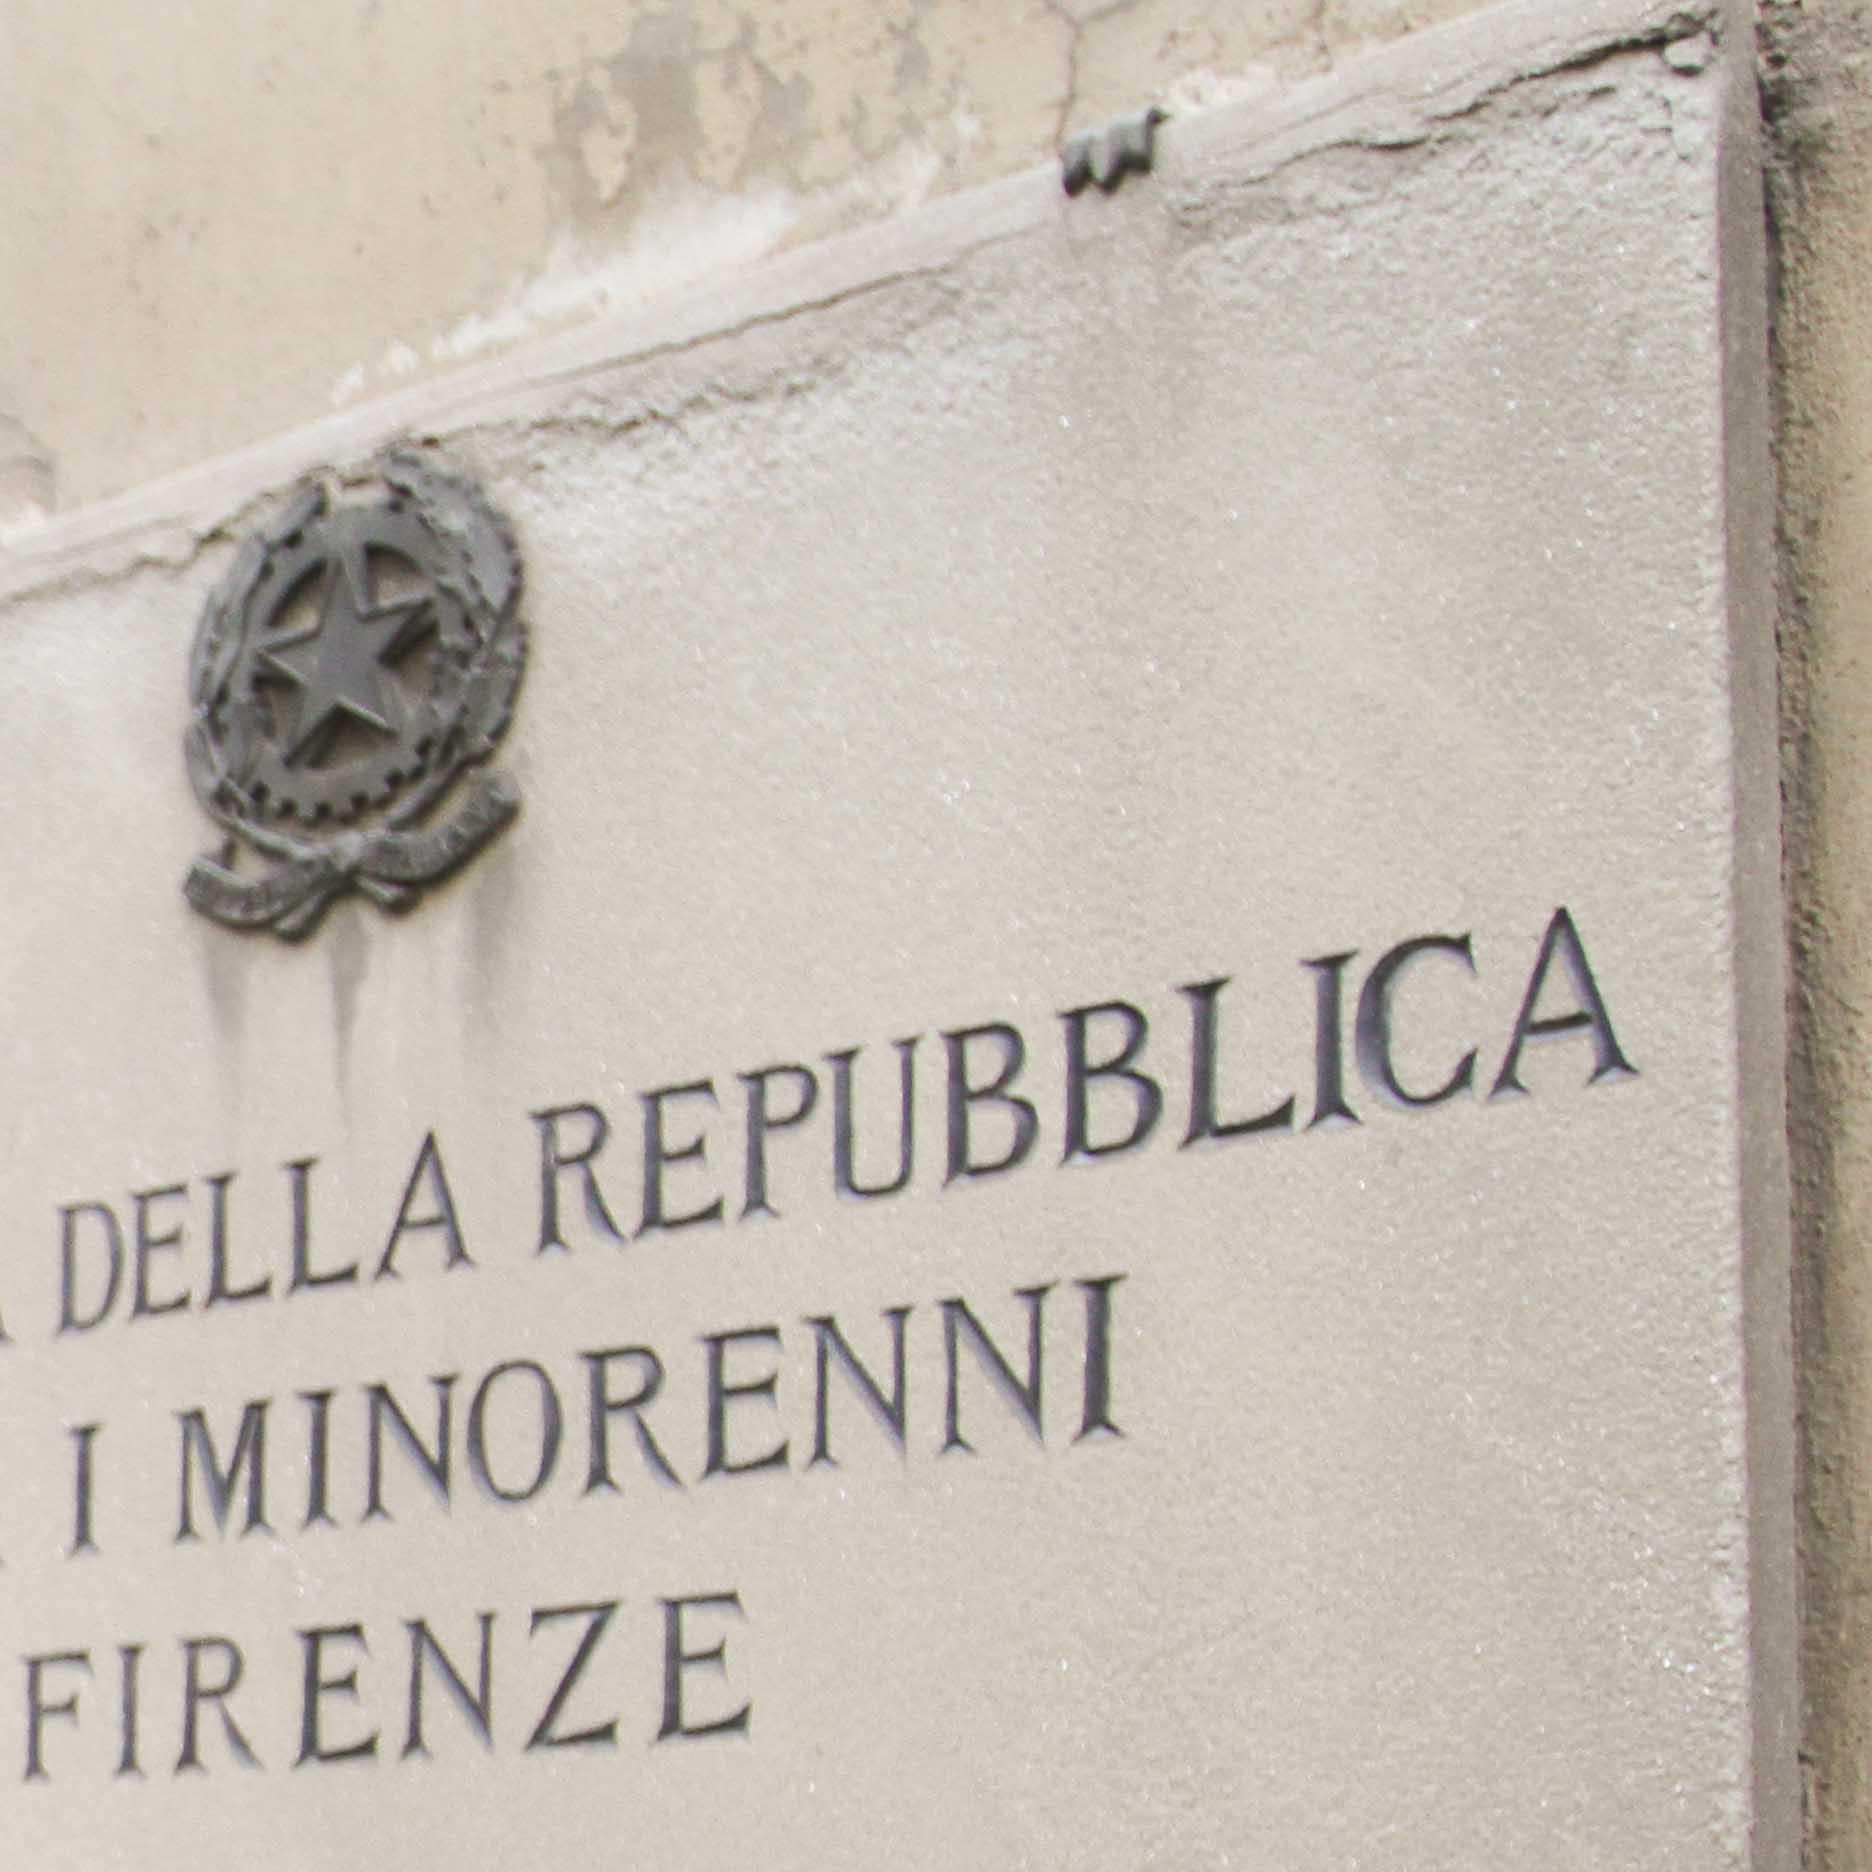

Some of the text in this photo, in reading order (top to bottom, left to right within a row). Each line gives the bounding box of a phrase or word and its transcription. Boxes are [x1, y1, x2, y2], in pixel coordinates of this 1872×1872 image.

[55, 1129, 476, 1336] DELLA
[526, 904, 1643, 1256] REPUBBLICA
[67, 1421, 102, 1557] I
[171, 1272, 1130, 1545] MINORENNI
[21, 1589, 753, 1783] FIRENZE
